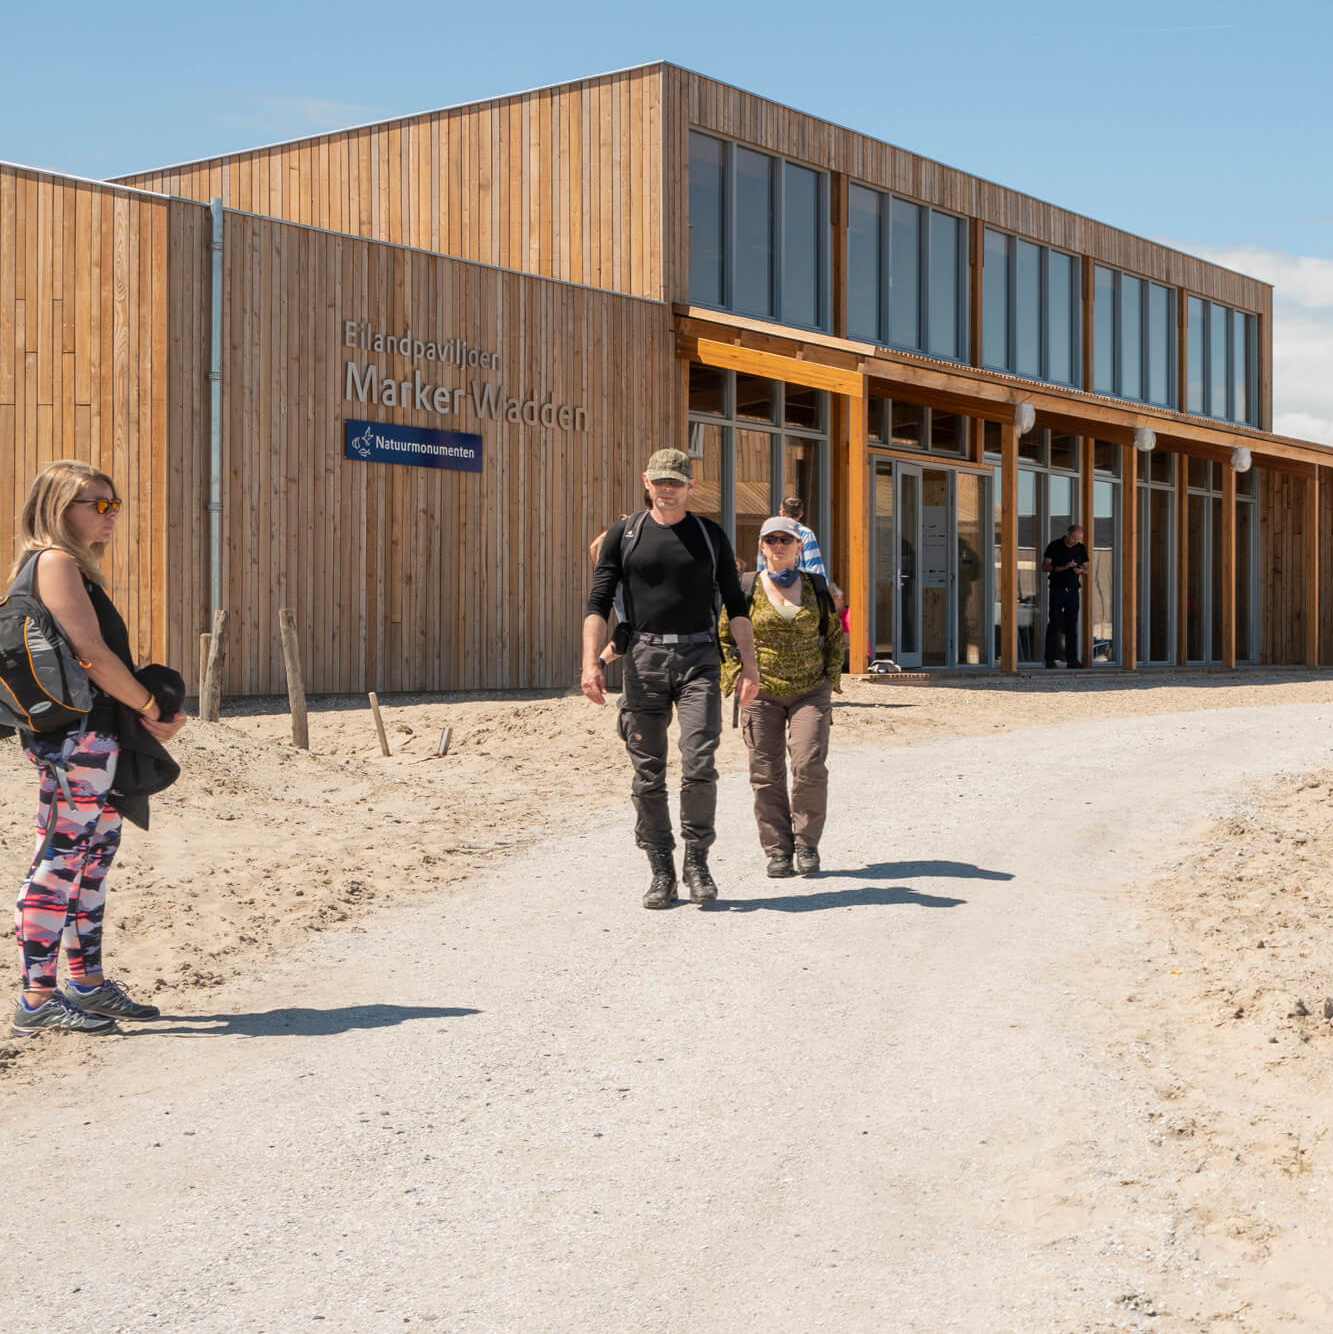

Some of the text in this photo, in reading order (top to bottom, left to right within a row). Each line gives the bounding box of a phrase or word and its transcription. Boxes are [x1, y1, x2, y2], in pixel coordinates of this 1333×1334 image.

[344, 320, 500, 370] Eilandpaviljoen
[345, 362, 588, 432] Marker Wadden
[375, 435, 475, 459] Natuurmonumenten
